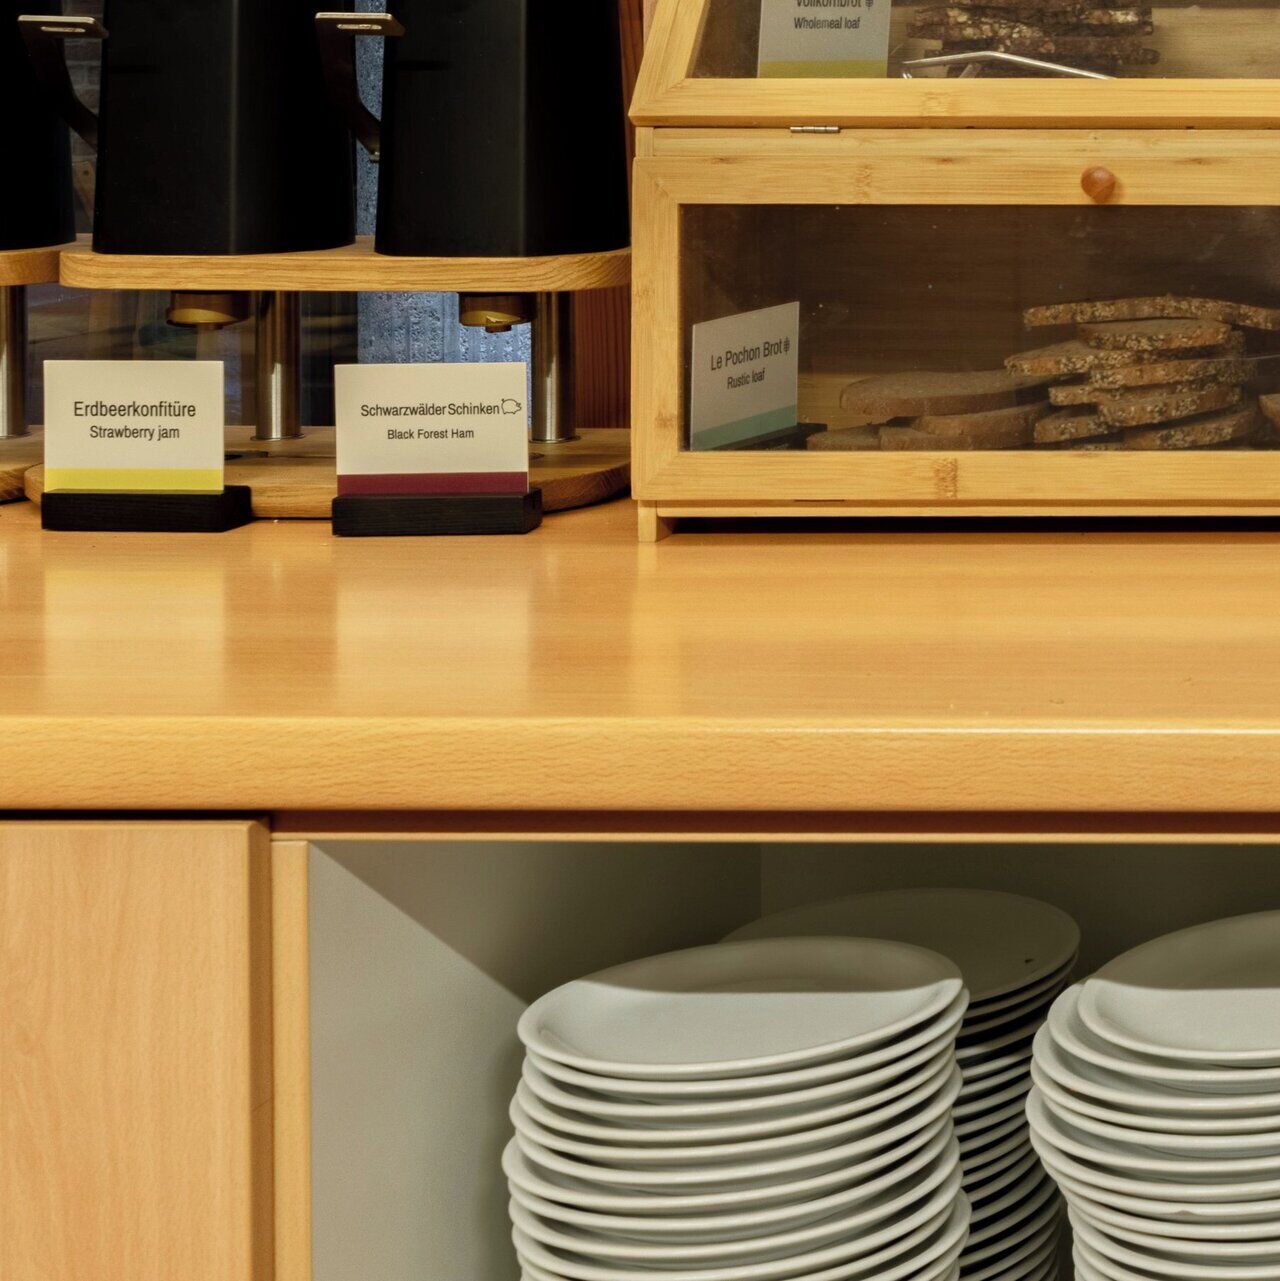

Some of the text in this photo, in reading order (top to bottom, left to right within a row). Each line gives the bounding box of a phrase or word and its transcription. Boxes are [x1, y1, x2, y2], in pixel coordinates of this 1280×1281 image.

[794, 16, 861, 30] Wholemeal loaf
[711, 339, 782, 371] Le Pochon Brot
[727, 367, 766, 390] Rustic loaf
[73, 400, 196, 418] Erdbeerkonfitüre
[360, 402, 500, 417] Schwarzwälder Schinken
[89, 425, 180, 441] Strawberry jam
[387, 428, 475, 440] Black Forest Ham
